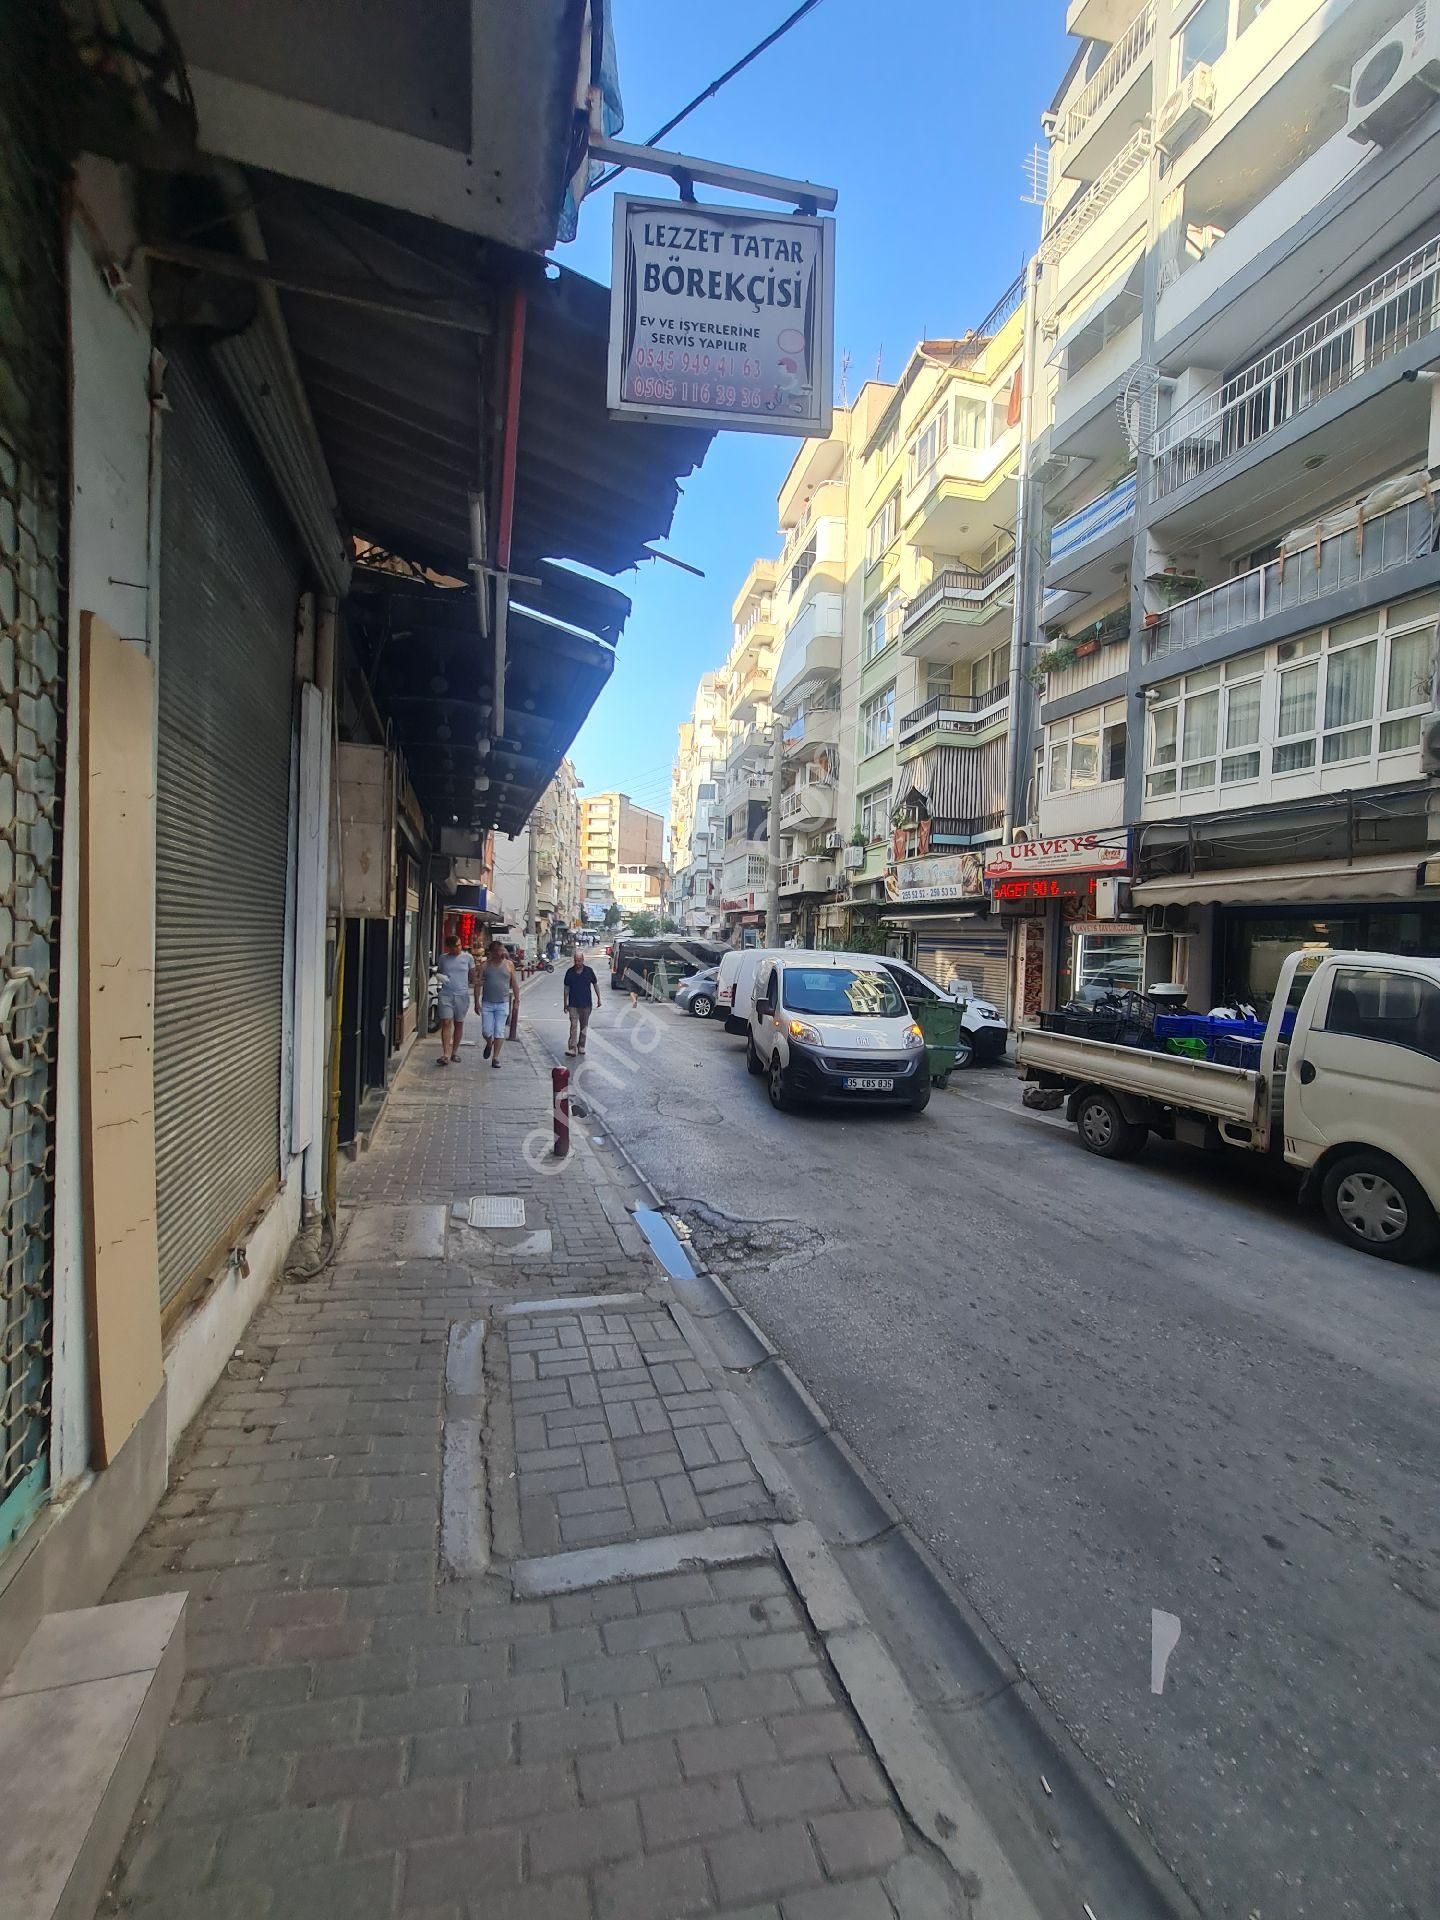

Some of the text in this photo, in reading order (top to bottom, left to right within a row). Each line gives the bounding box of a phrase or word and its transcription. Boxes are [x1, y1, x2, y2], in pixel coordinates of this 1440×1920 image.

[644, 223, 804, 264] LEZZET TATAR
[643, 255, 802, 313] BÖREKÇİSİ
[640, 316, 760, 338] EV VE İŞYERLERİNE
[651, 332, 747, 352] SERVİS YAPILIR
[636, 347, 761, 378] 0545 949 41 63
[634, 375, 674, 400] 0505
[681, 382, 710, 402] 116
[1010, 835, 1098, 858] UKVEYS
[848, 1079, 857, 1087] 35
